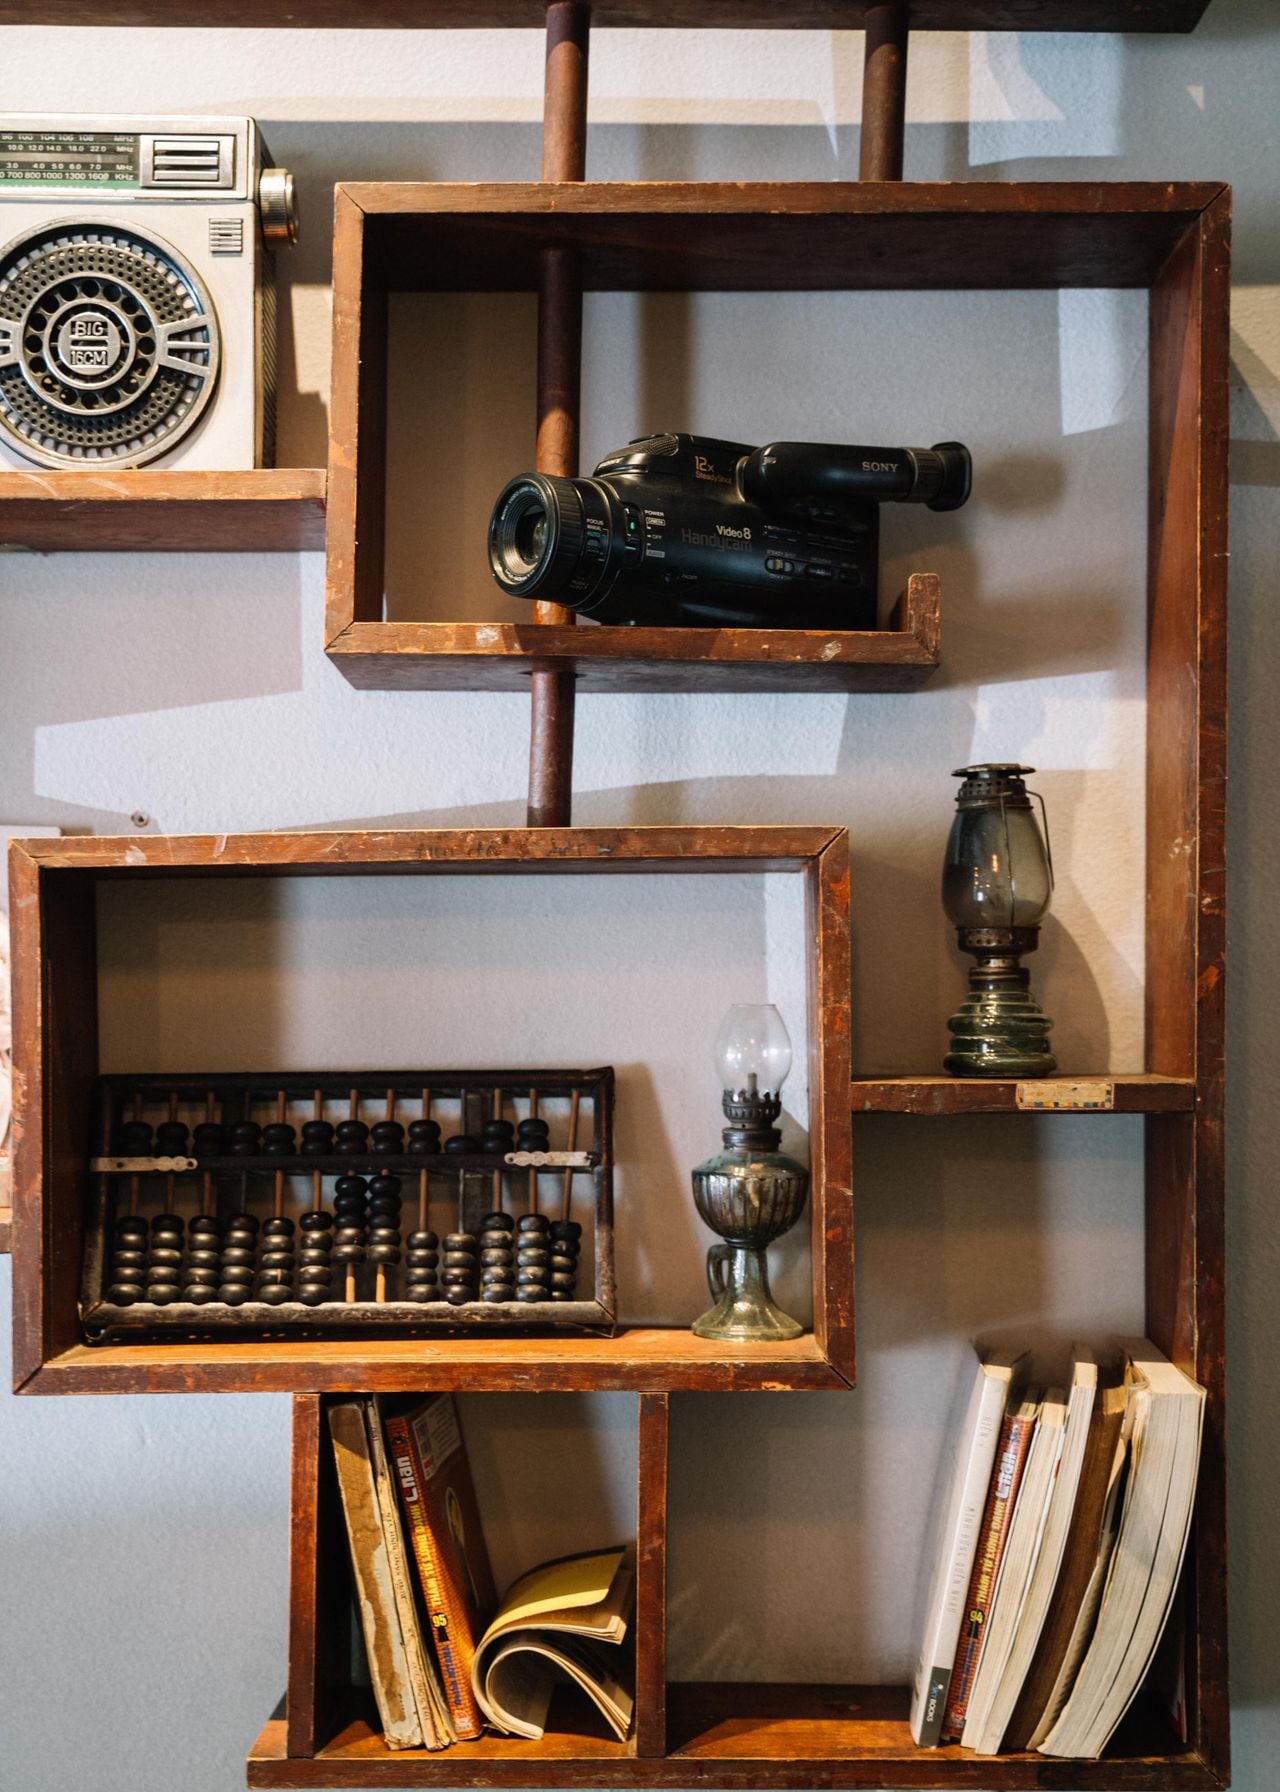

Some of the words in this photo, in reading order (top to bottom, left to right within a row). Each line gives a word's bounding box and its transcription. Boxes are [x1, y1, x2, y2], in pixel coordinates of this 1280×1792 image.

[114, 173, 134, 181] KHz
[74, 321, 104, 336] BIG
[71, 351, 107, 365] 16CM
[694, 455, 714, 472] 12x
[861, 461, 899, 473] SONY
[681, 528, 753, 553] Handycam
[432, 1614, 448, 1627] 95
[970, 1610, 984, 1624] 94
